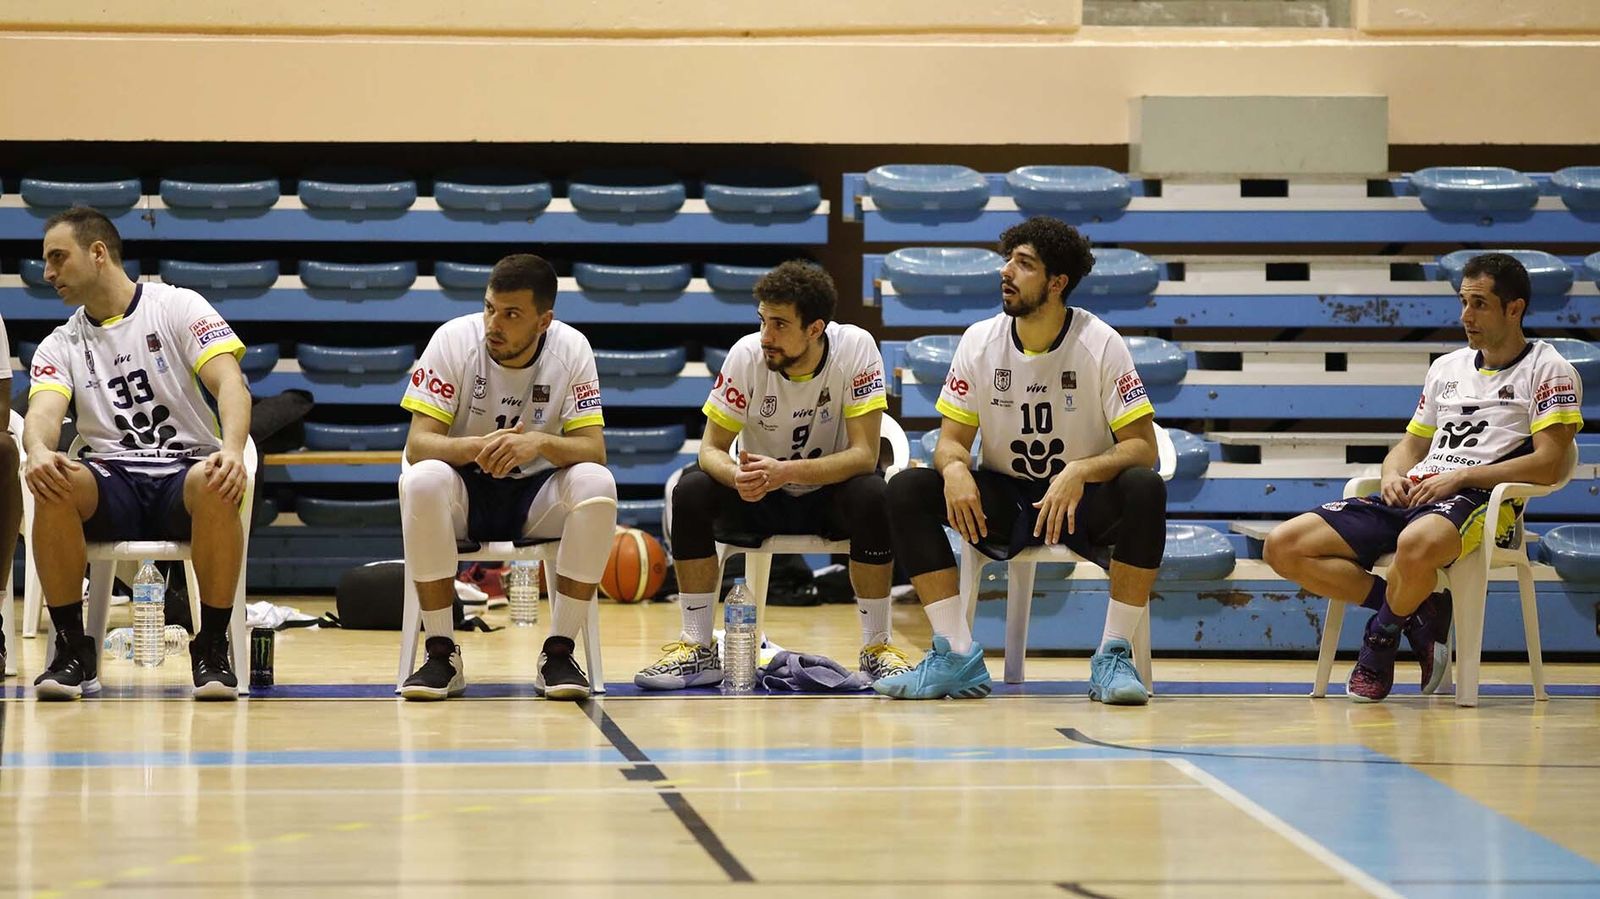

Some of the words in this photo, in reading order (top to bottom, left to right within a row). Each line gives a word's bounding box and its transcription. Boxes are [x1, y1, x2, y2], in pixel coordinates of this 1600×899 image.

[107, 368, 155, 409] 33
[1026, 382, 1048, 393] vive
[1020, 402, 1053, 435] 10
[791, 424, 809, 450] 9
